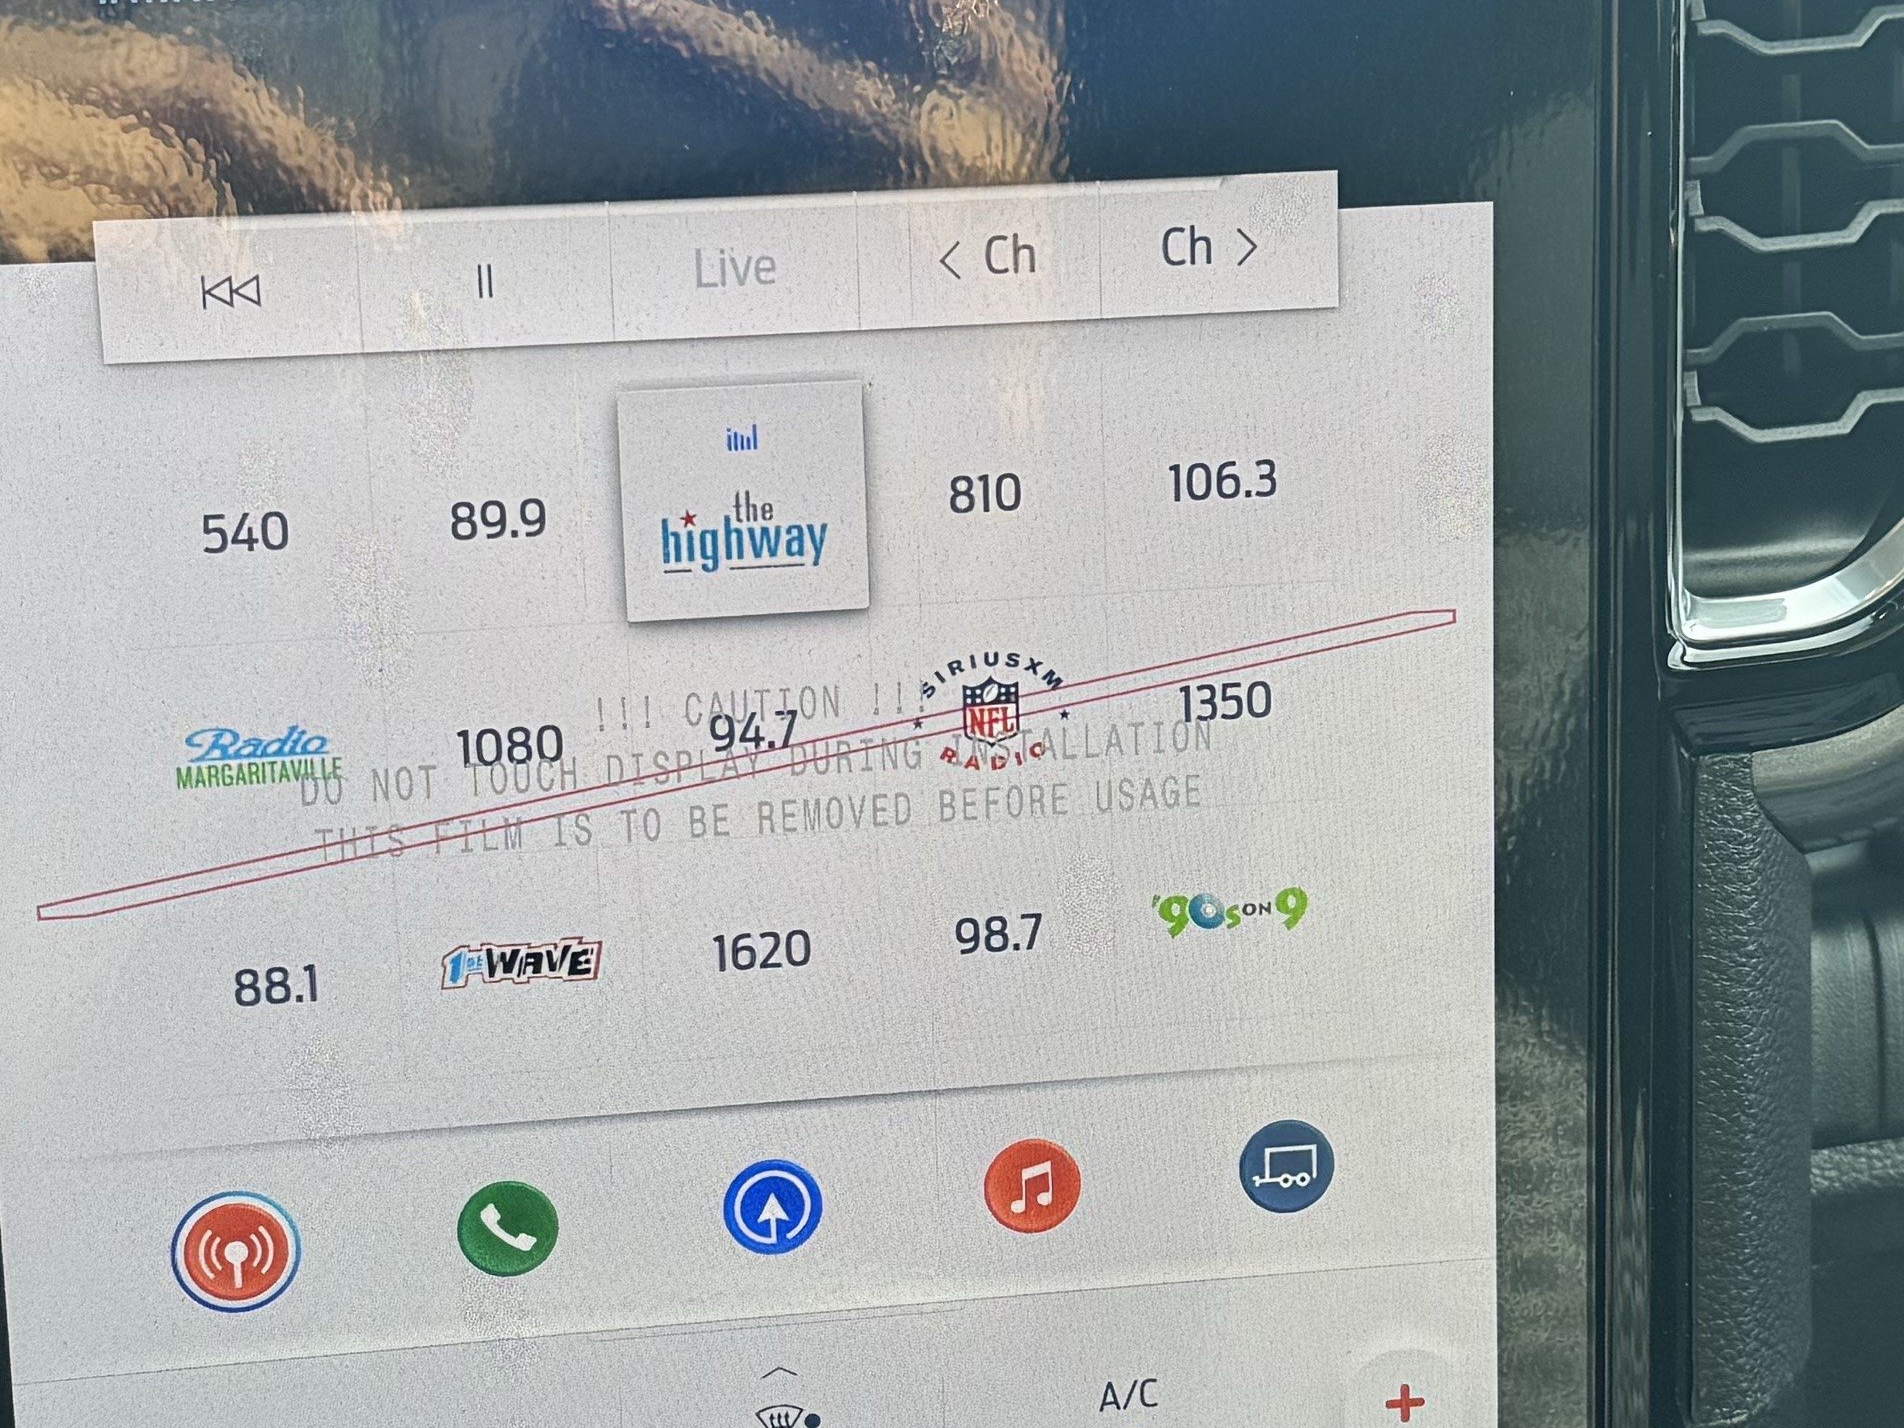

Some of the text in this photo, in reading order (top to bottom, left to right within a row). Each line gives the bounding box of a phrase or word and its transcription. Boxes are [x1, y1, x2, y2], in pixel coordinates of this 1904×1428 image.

[693, 246, 778, 291] Live
[984, 234, 1038, 278] Ch
[1162, 226, 1214, 269] Ch
[949, 472, 1022, 514] 810
[1167, 458, 1278, 502] 106.3
[451, 497, 546, 541] 89.9
[732, 489, 774, 523] the
[202, 510, 289, 555] 540
[661, 511, 828, 573] highway
[921, 651, 1064, 699] SIRIUSXM
[684, 684, 841, 727] CAUTION
[967, 705, 1017, 738] NFL
[1178, 680, 1272, 722] 1350
[184, 723, 330, 763] Radio
[456, 723, 564, 768] 1080
[709, 709, 798, 752] 94.7
[175, 756, 343, 791] MARGARITAVILLE
[300, 718, 1212, 807] DO NOT TOUCH DISPLAY DURING INSTALLATION
[939, 742, 1047, 772] RADIO
[314, 774, 1201, 863] THIS FILM IS TO BE REMOVED BEFORE USAGE
[1274, 885, 1308, 931] 9
[712, 928, 812, 973] 1620
[954, 911, 1043, 955] 98.7
[234, 963, 318, 1007] 88.1
[1098, 1377, 1159, 1413] A/C
